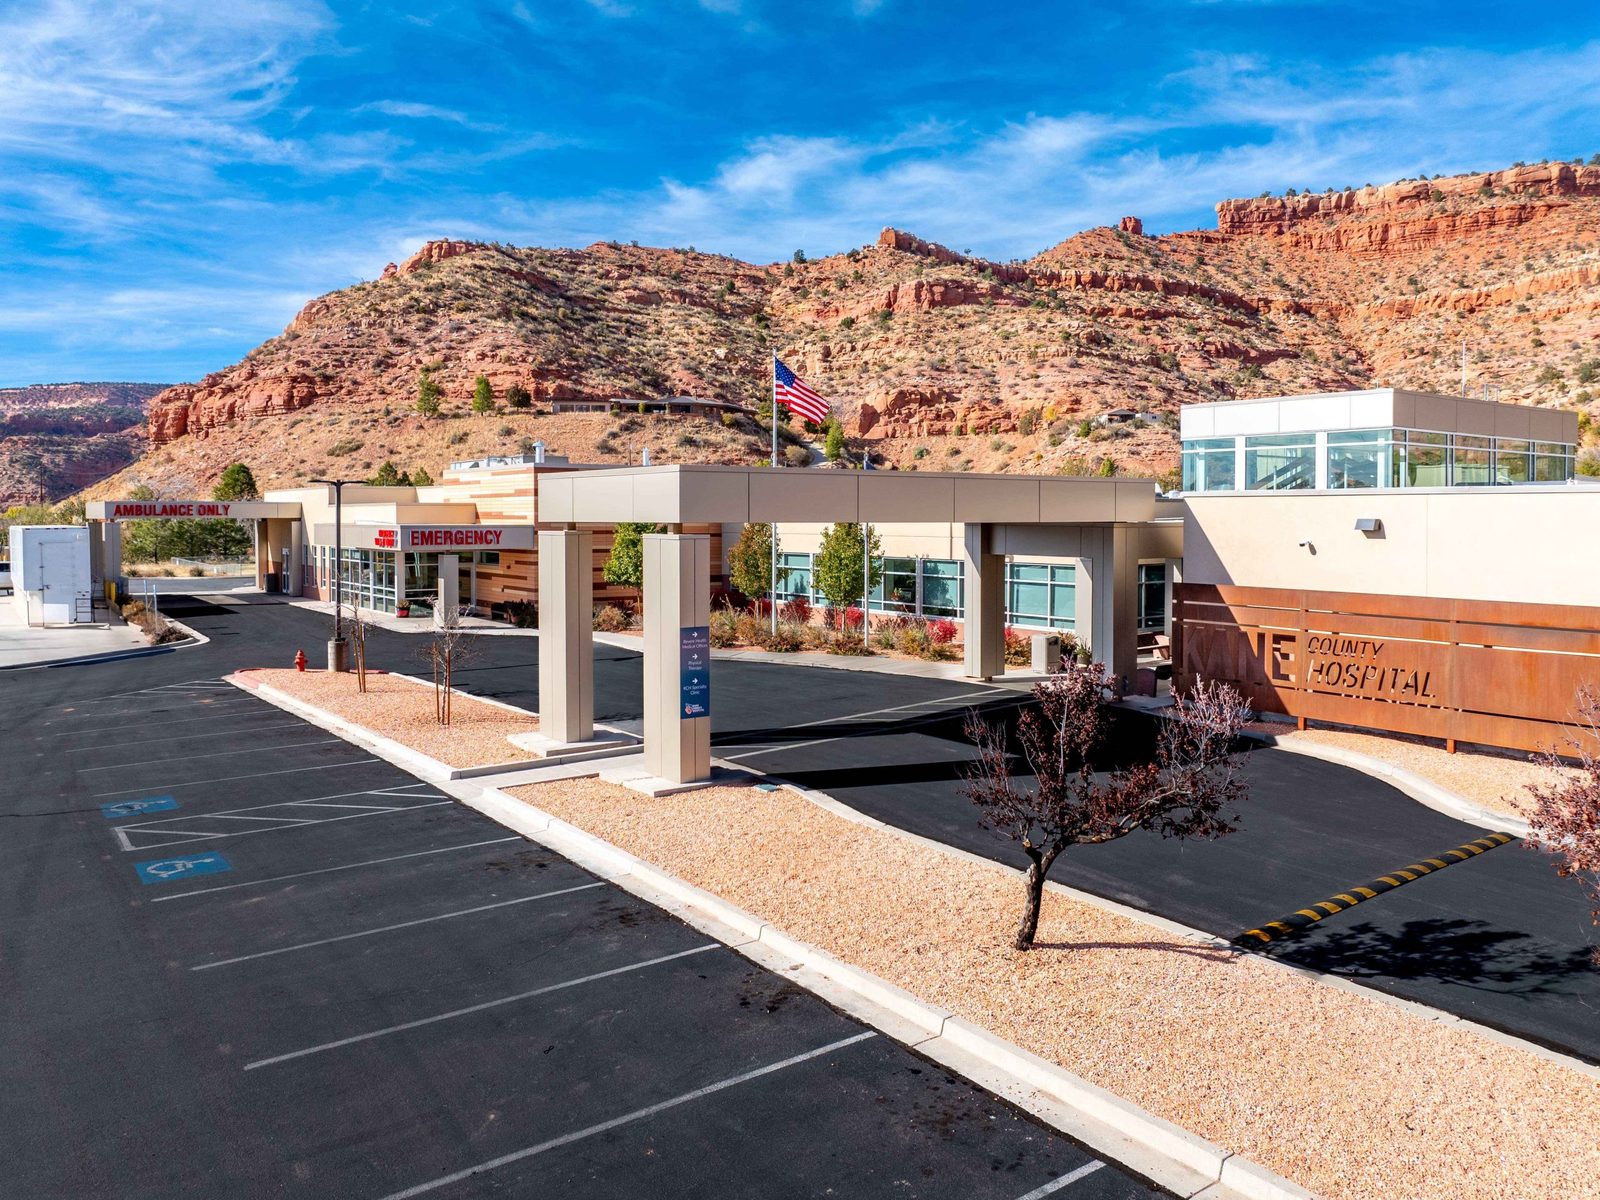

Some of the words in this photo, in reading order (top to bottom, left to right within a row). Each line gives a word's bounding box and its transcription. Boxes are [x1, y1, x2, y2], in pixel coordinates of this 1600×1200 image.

[114, 504, 194, 517] AMBULANCE
[198, 504, 231, 516] ONLY
[410, 529, 503, 546] EMERGENCY
[1181, 623, 1297, 682] KANE
[1307, 636, 1385, 660] COUNTY
[1306, 659, 1437, 698] HOSPITAL
